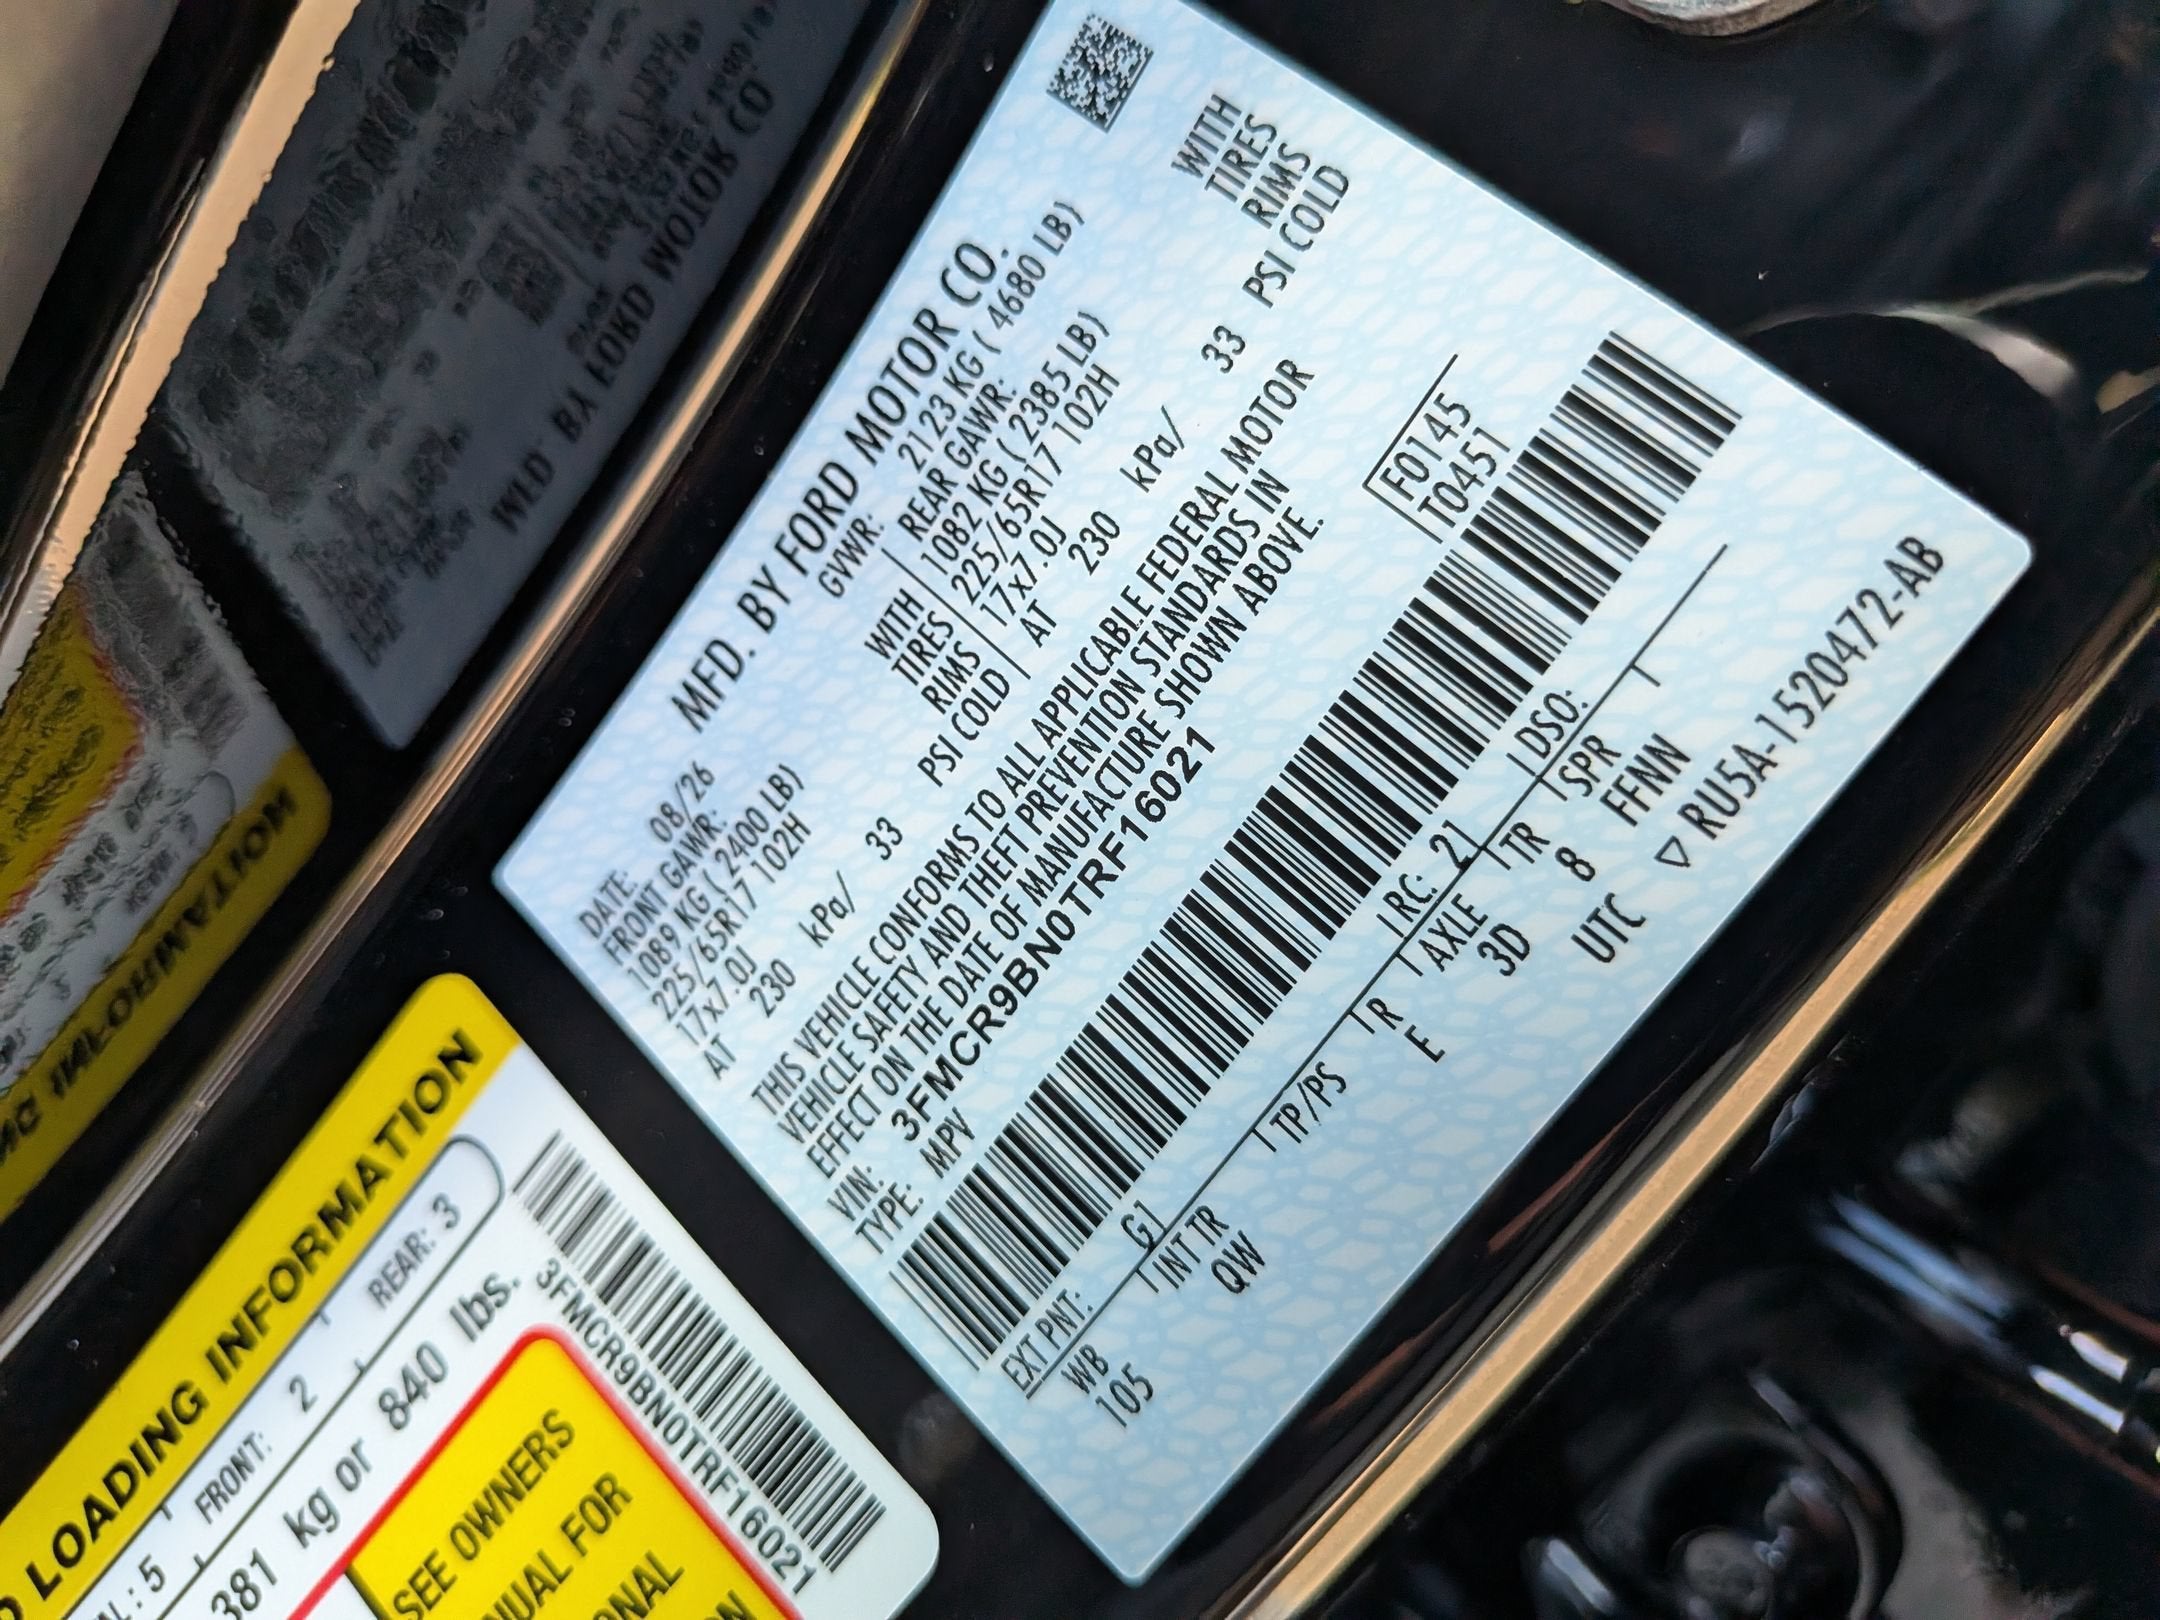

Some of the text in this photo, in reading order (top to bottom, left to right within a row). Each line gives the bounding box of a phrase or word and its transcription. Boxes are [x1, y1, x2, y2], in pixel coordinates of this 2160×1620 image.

[1171, 94, 1242, 178] WITH
[1204, 113, 1277, 203] TIRES
[1241, 142, 1311, 229] RIMS
[818, 514, 884, 599] GVWR:
[897, 394, 957, 474] 2123
[942, 350, 984, 399] KG
[1032, 201, 1085, 256] LB)
[920, 501, 983, 576] 1082
[966, 458, 1009, 508] KG
[1056, 310, 1110, 368] LB)
[1019, 165, 1349, 648] AT 230 kPa/ 33 PSI COLD
[1379, 392, 1471, 502] F0145
[670, 242, 1009, 734] MFD. BY FORD MOTOR CO.
[897, 378, 1017, 543] REAR GAWR:
[951, 363, 1120, 606] 225/65R17 102H
[1416, 426, 1511, 529] T0451
[979, 515, 1067, 627] 17x7.0J
[864, 588, 925, 660] WITH
[891, 610, 954, 686] TIRES
[920, 640, 981, 715] RIMS
[1514, 690, 1589, 760] DSO:
[1677, 536, 1944, 840] RU5A-1520472-AB
[751, 359, 1315, 1116] THIS VEHICLE CONFORMS TO ALL APPLICABLE FEDERAL MOTOR
[1558, 735, 1622, 797] SPR
[1599, 732, 1691, 827] FFNN
[578, 761, 715, 938] DATE: 08/26
[777, 468, 1290, 1144] VEHICLE SAFETY AND THEFT PREVENTION STANDARDS IN
[806, 506, 1324, 1180] EFFECT ON THE DATE OF MANUFACTURE SHOWN ABOVE.
[1498, 822, 1551, 864] TR
[602, 810, 727, 965] FRONT GAWR:
[627, 923, 681, 990] 1089
[673, 886, 710, 932] KG
[759, 763, 805, 813] LB)
[703, 668, 1010, 1080] AT 230 kPa/ 33 PSI COLD
[1382, 873, 1438, 923] RC:
[1555, 846, 1596, 882] 8
[651, 811, 811, 1022] 225/65R17 102H
[1417, 893, 1489, 973] AXLE
[1476, 923, 1531, 977] 3D
[1571, 892, 1647, 963] UTC
[676, 945, 757, 1045] 17x7.0J
[827, 726, 1215, 1222] VIN: 3FMCR9BN0TRF16021
[1366, 997, 1404, 1031] R
[1404, 1024, 1446, 1063] E
[1269, 1061, 1346, 1144] TP/PS
[854, 1106, 975, 1255] TYPE: MPV
[367, 1192, 461, 1309] REAR: 3
[1152, 1205, 1230, 1290] INT TR
[1211, 1230, 1266, 1295] QW
[25, 1030, 480, 1602] LOADING INFORMATION
[1000, 1333, 1048, 1392] EXT
[1034, 1289, 1093, 1351] PNT:
[283, 1489, 339, 1549] kg
[335, 1440, 370, 1492] or
[378, 1344, 446, 1431] 840
[449, 1272, 521, 1343] lbs.
[1060, 1344, 1109, 1395] WB
[1095, 1363, 1154, 1428] 105
[194, 1376, 315, 1525] FRONT: 2
[536, 1257, 817, 1596] 3FMCR9BN0TRF16021
[393, 1410, 573, 1620] SEE OWNERS
[560, 1474, 631, 1557] FOR
